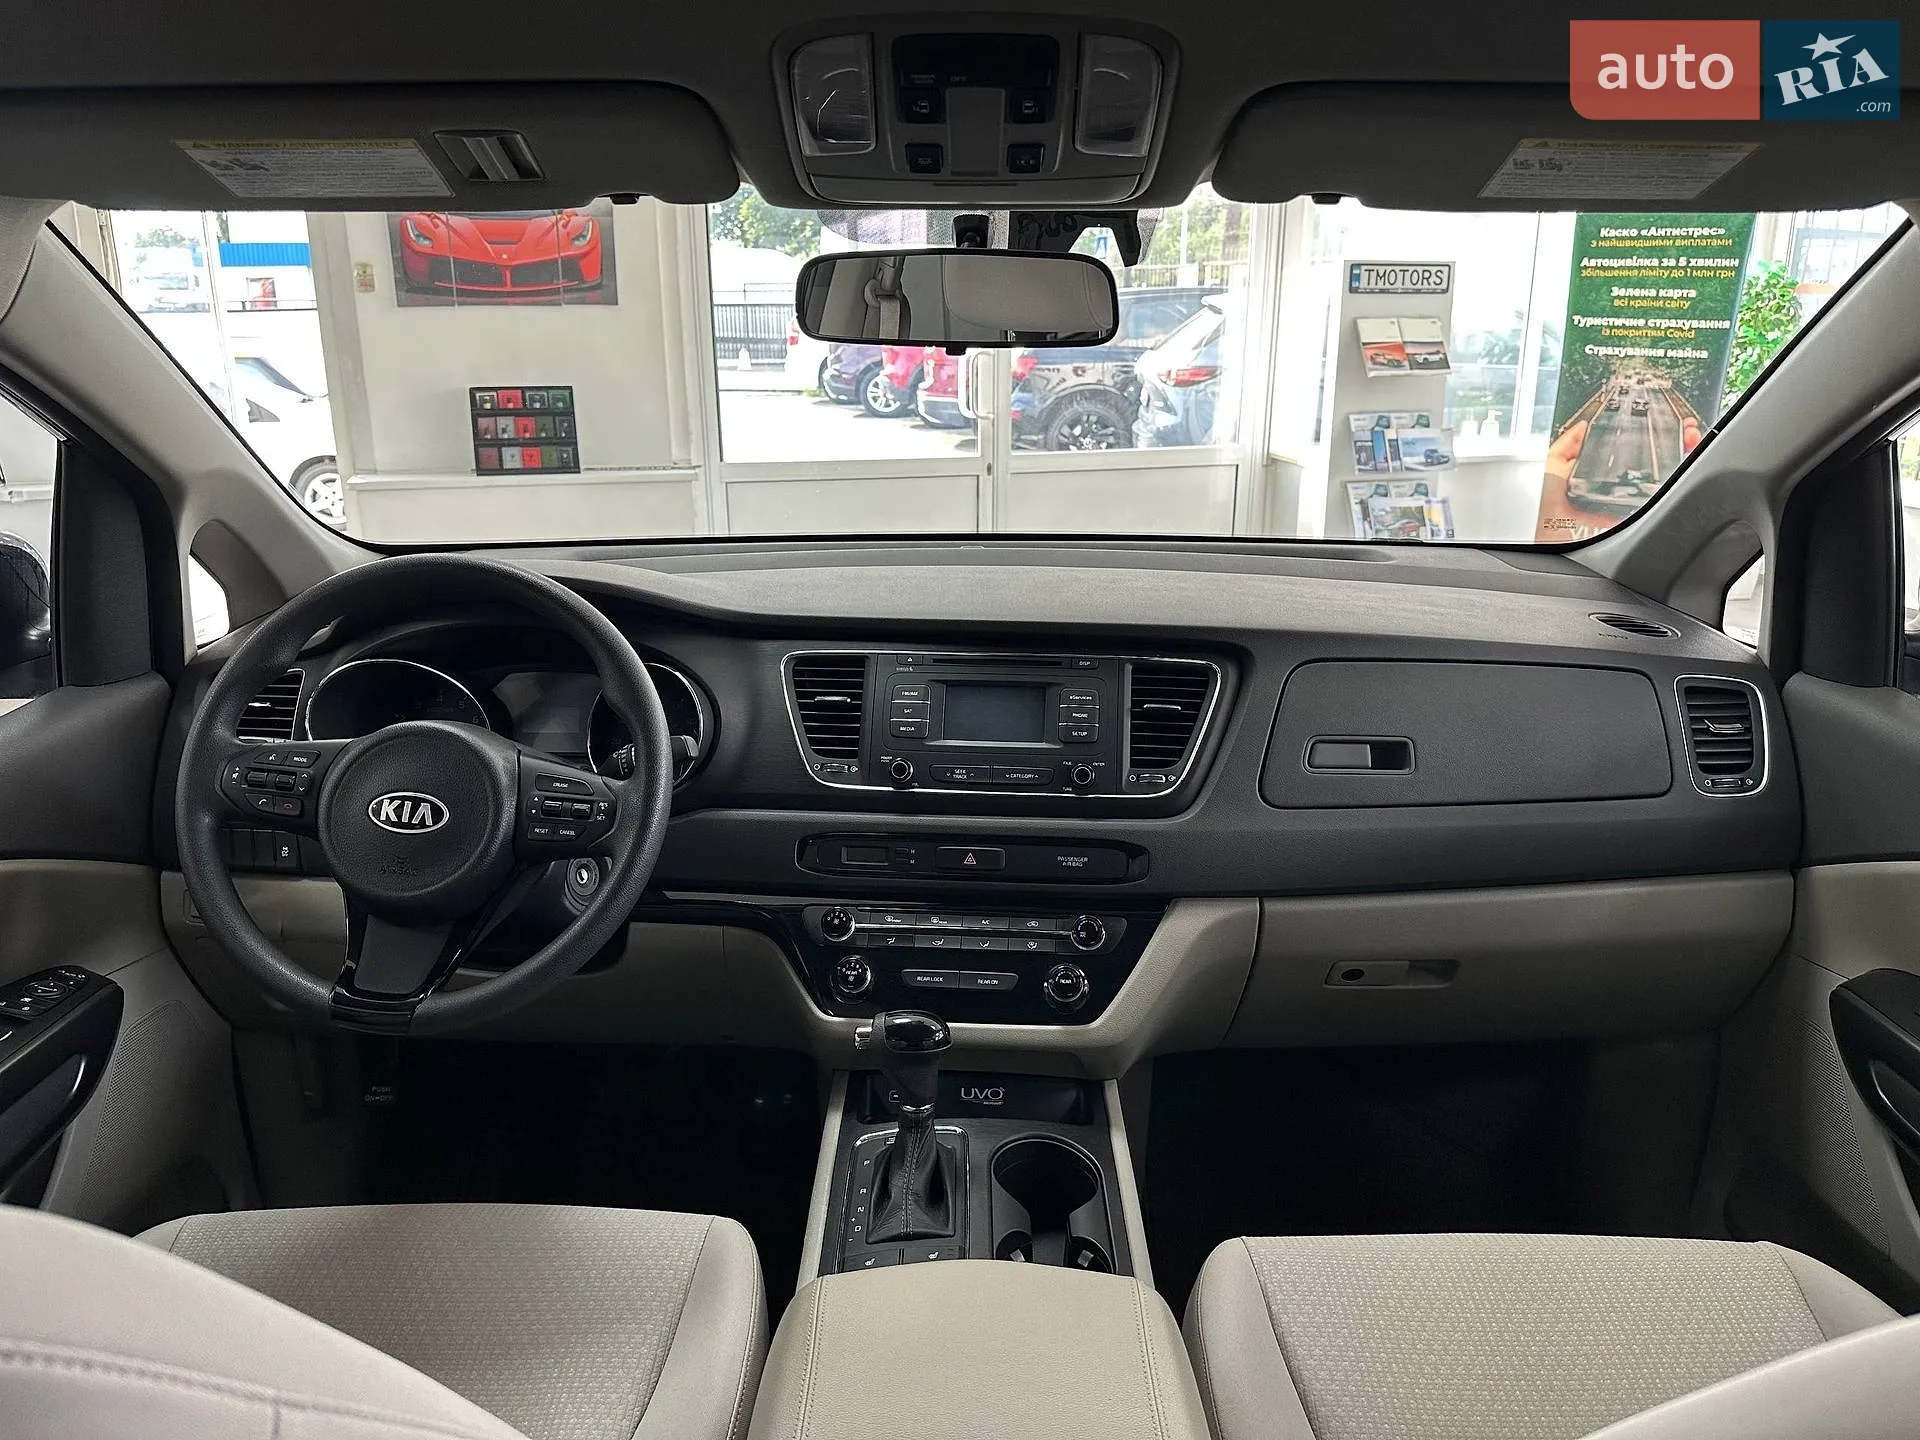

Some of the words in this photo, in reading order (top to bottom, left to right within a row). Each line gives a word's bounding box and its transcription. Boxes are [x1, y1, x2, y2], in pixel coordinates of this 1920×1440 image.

[1600, 226, 1638, 238] Каско
[1640, 226, 1726, 239] «Антистрес»
[1590, 240, 1597, 248] з
[1598, 239, 1673, 248] найшвидшими
[1675, 238, 1733, 247] виплатами
[1580, 256, 1659, 268] Автоцивілка
[1660, 258, 1676, 267] за
[1678, 257, 1687, 267] 5
[1688, 257, 1740, 267] хвилин
[1364, 268, 1444, 287] TMOTORS
[1580, 267, 1639, 277] збільшення
[1639, 268, 1670, 279] ліміту
[1670, 270, 1685, 278] до
[1716, 270, 1735, 279] грн
[1610, 286, 1657, 297] Зелена
[1658, 288, 1697, 299] карта
[1613, 298, 1628, 307] всі
[1629, 298, 1664, 309] країни
[1665, 299, 1691, 309] світу
[1572, 315, 1646, 327] Туристичне
[1647, 319, 1731, 330] страхування
[1601, 328, 1610, 336] із
[1611, 329, 1665, 339] покриттям
[1666, 328, 1696, 339] Covid
[1584, 344, 1665, 358] Страхування
[1666, 348, 1709, 359] майна
[379, 798, 433, 826] KIA
[961, 1087, 1004, 1100] UVO
